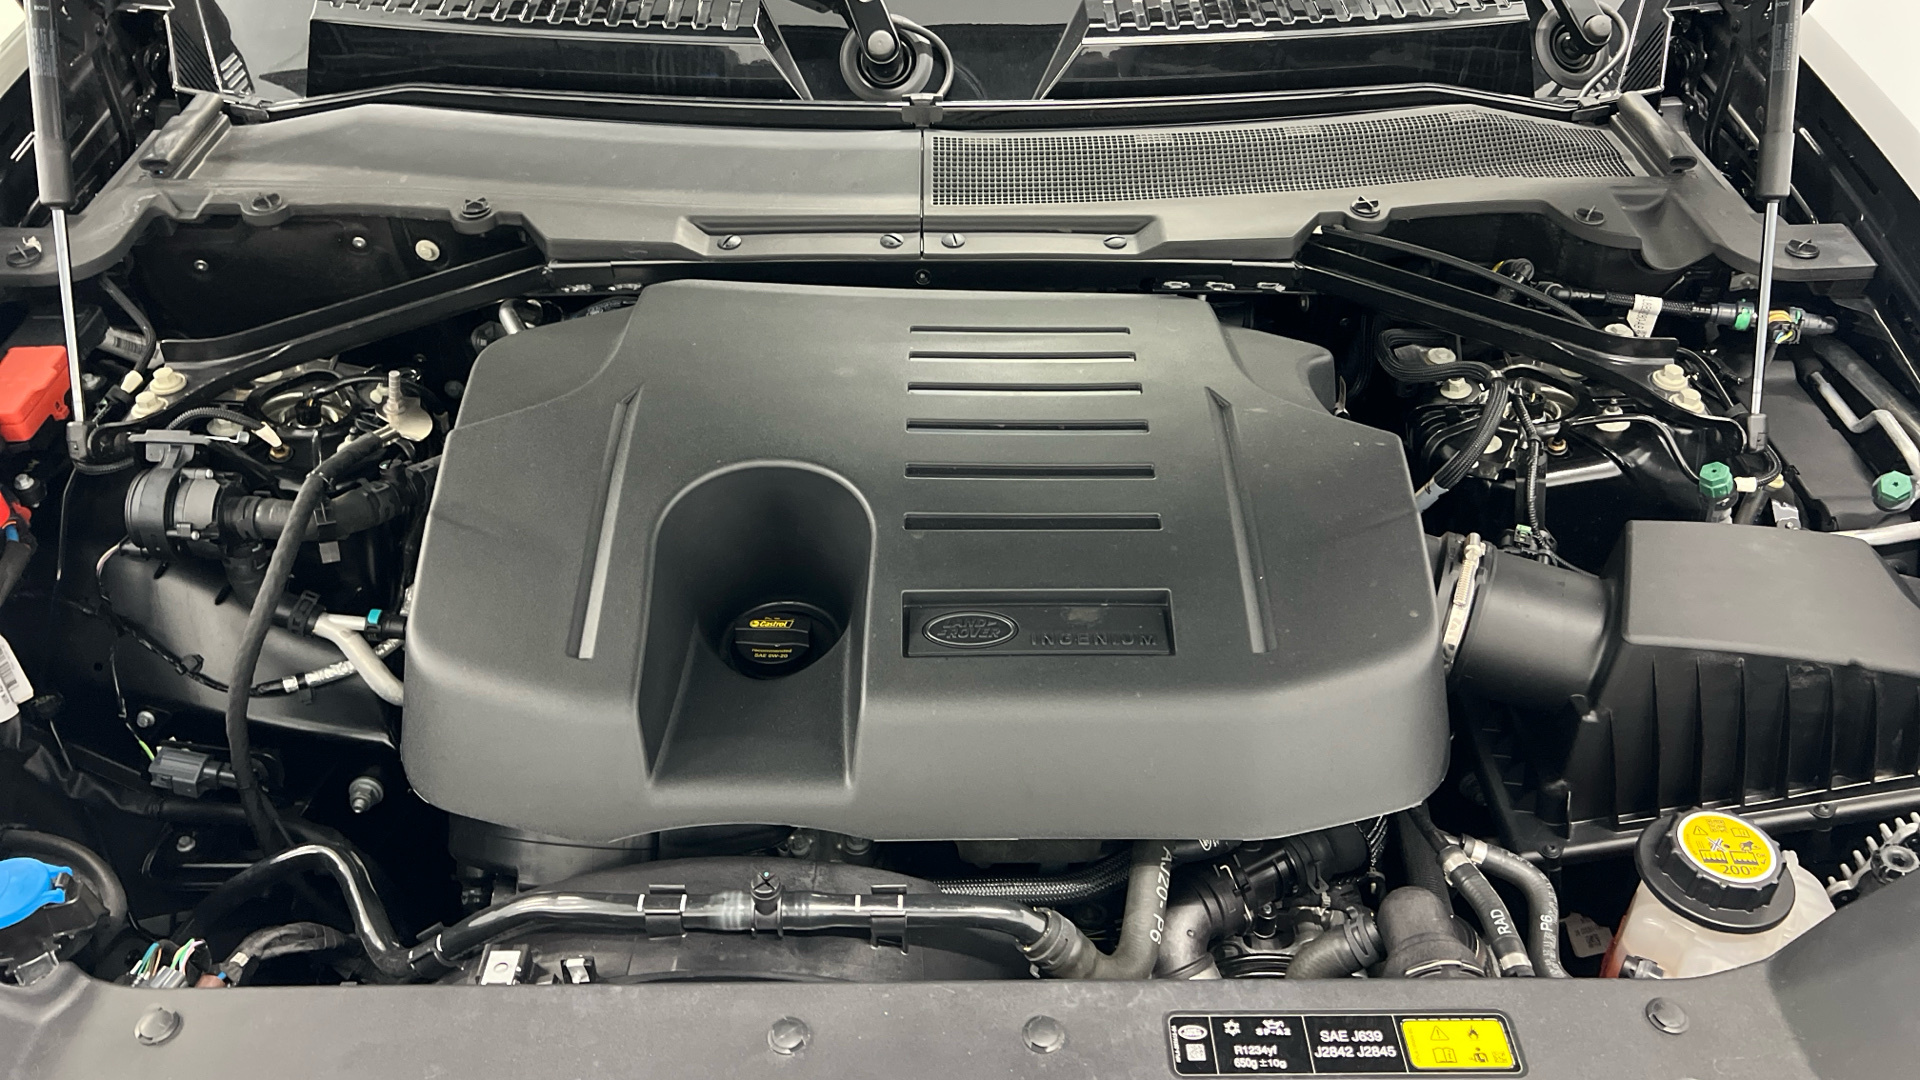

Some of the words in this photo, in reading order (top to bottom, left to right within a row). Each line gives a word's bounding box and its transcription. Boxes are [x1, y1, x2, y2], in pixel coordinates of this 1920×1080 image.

[759, 620, 788, 628] Castrol
[943, 618, 989, 629] LAND
[945, 628, 1001, 640] ROVER
[1030, 632, 1159, 647] INGENIUM
[1719, 864, 1750, 875] 200
[1490, 909, 1512, 935] RAD
[1540, 914, 1553, 932] P6
[1319, 1029, 1350, 1043] SAE
[1350, 1029, 1384, 1042] J639
[1233, 1044, 1278, 1057] R1234yf
[1314, 1045, 1355, 1058] J2842
[1356, 1045, 1397, 1058] J2845
[1233, 1057, 1259, 1070] 650g
[1258, 1058, 1288, 1070] ±10g
